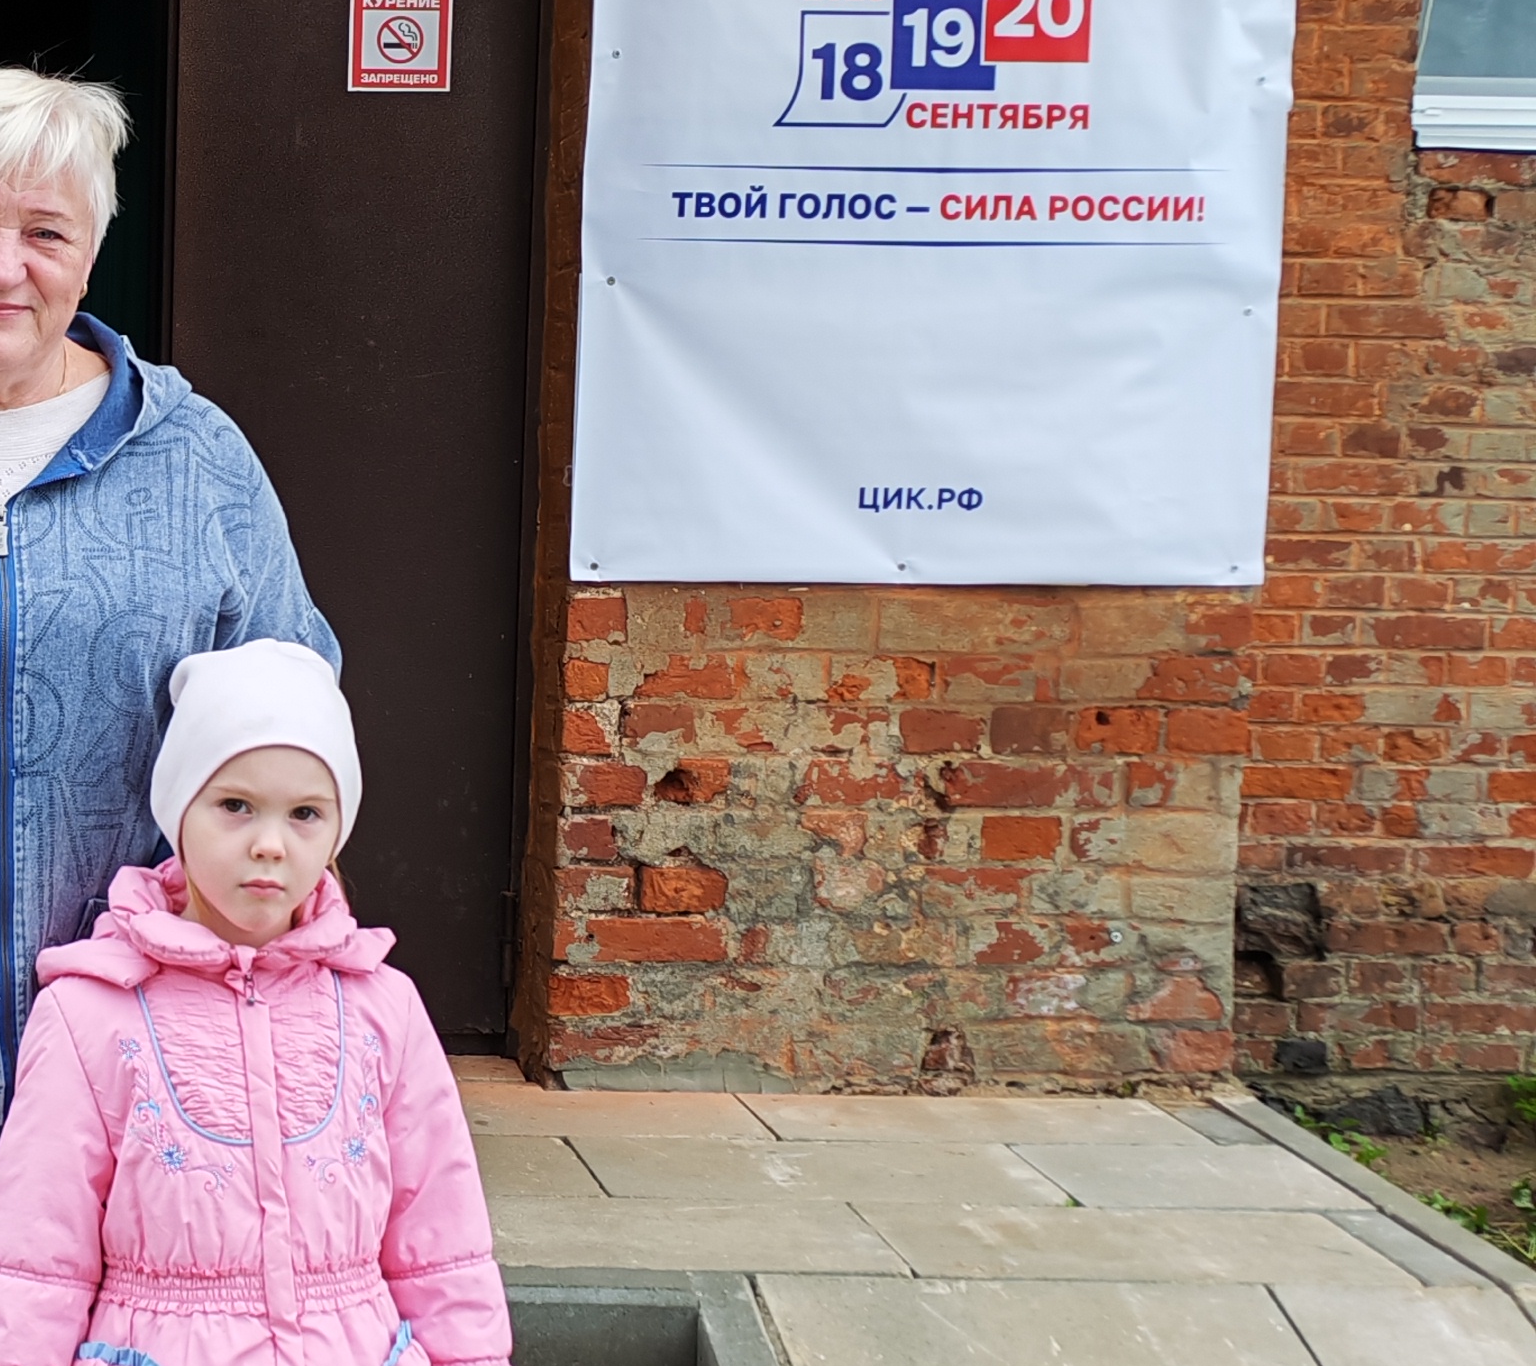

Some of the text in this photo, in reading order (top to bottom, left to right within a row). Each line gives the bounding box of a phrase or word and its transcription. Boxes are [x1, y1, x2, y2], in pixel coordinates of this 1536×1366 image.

[812, 42, 883, 101] 18
[902, 7, 975, 68] 19
[360, 73, 438, 85] ЗАПРЕЩЕНО
[905, 102, 1090, 130] СЕНТЯБРЯ
[672, 185, 767, 220] ТВОЙ
[778, 193, 897, 221] ГОЛОС
[939, 193, 1037, 221] СИЛА
[1048, 195, 1206, 223] РОССИИ!
[858, 487, 984, 513] ЦИК.РФ
